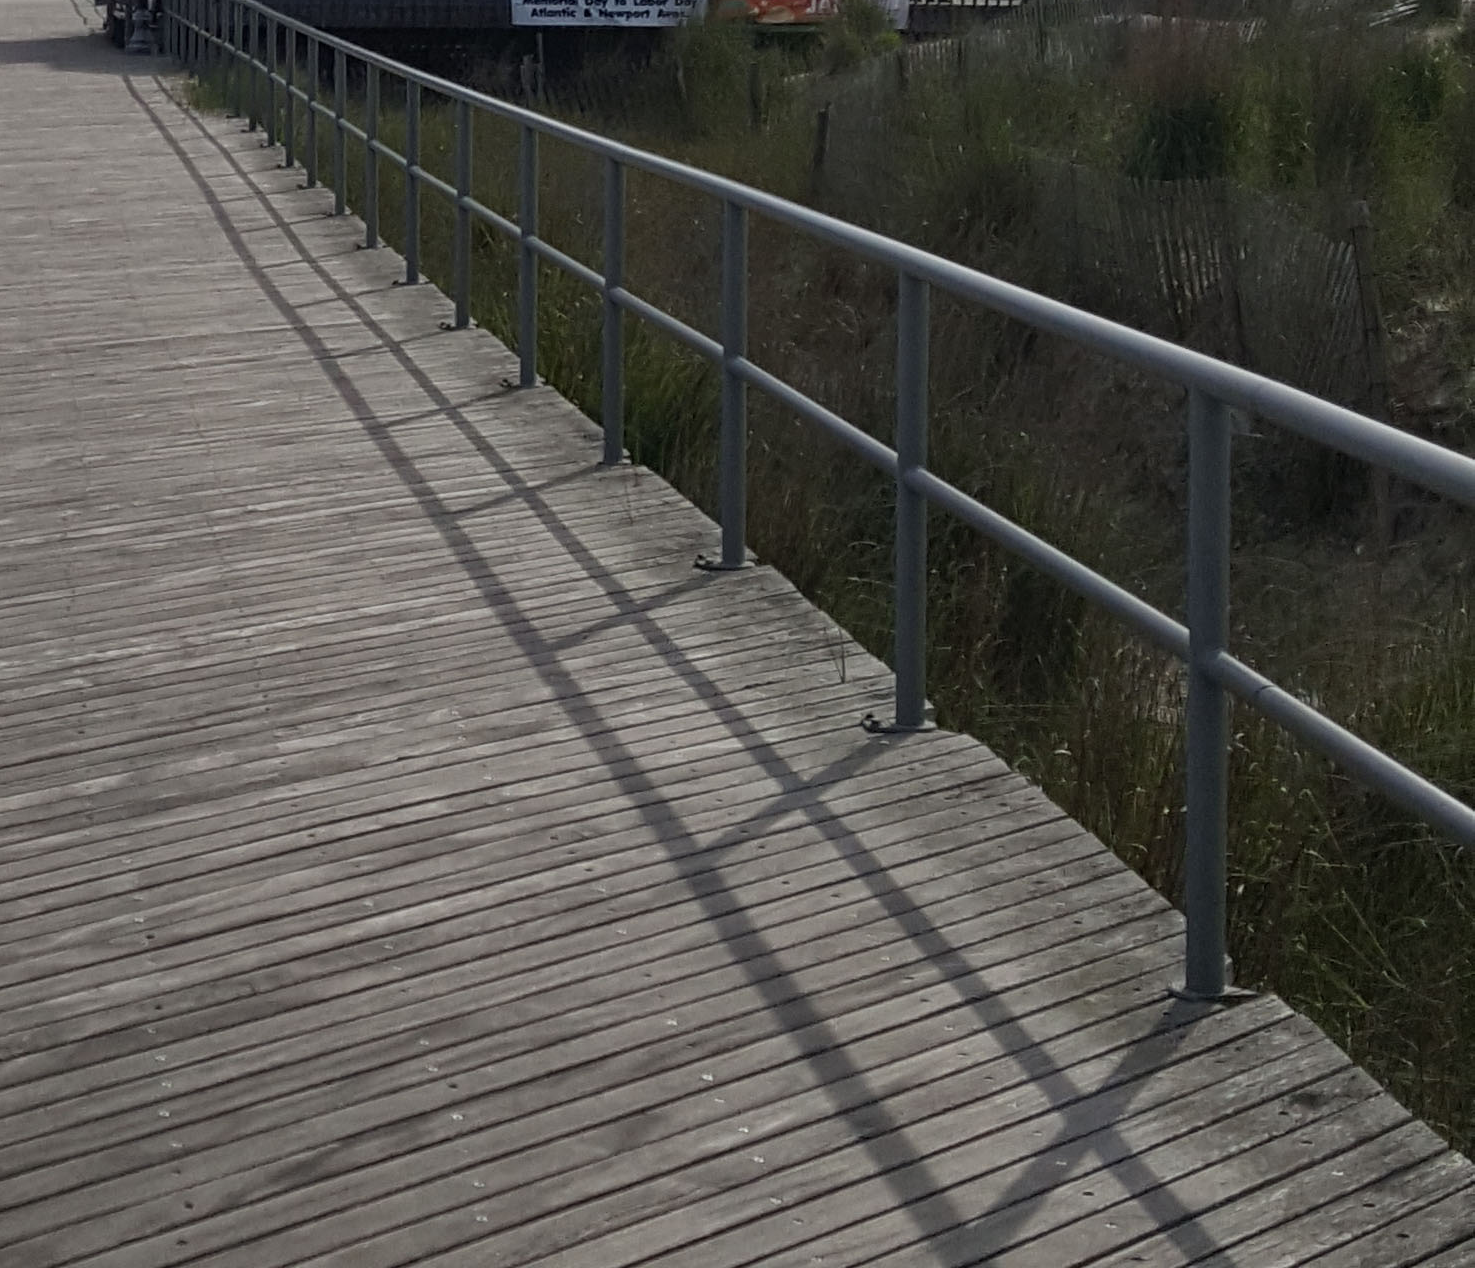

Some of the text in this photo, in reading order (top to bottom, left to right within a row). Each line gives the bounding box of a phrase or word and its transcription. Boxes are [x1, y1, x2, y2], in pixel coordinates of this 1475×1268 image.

[530, 8, 577, 19] Atlantic
[584, 8, 593, 19] &
[598, 8, 650, 21] Newport
